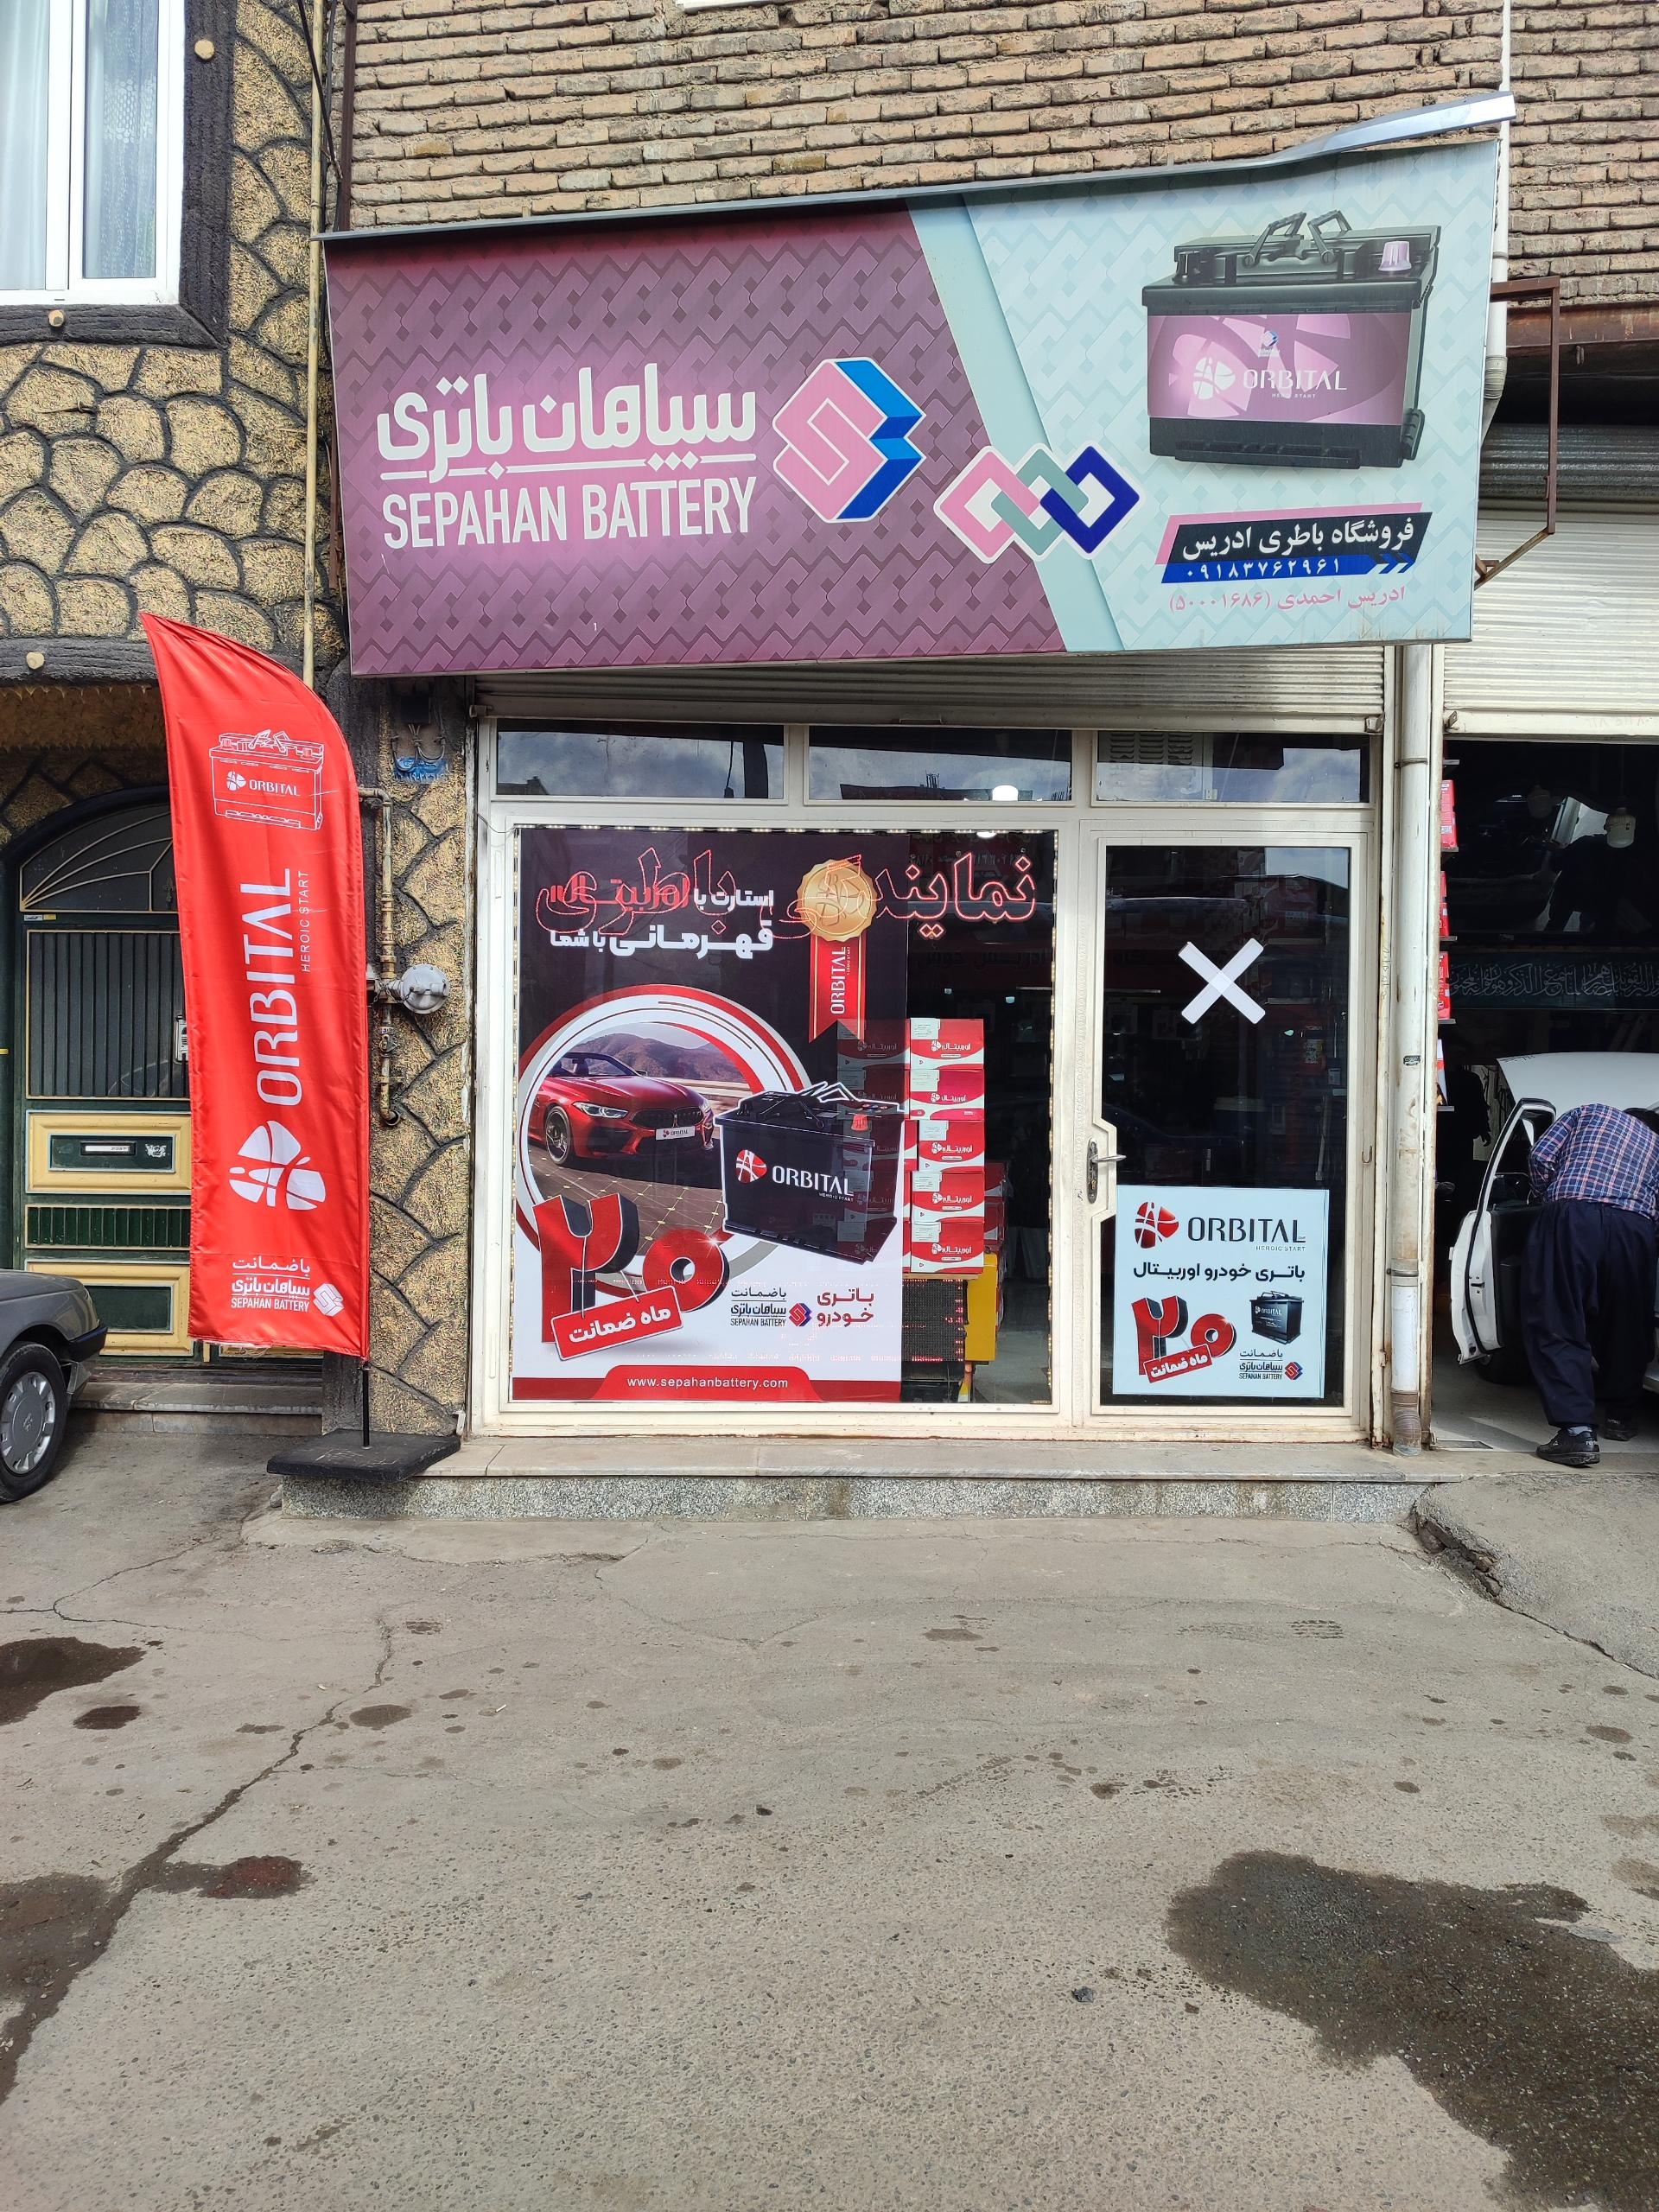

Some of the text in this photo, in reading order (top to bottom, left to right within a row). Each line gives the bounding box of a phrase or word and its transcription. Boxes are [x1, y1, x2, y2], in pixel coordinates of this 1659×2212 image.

[1243, 369, 1348, 391] ORBITAL
[376, 362, 758, 484] سپاهان باتری
[383, 476, 758, 550] SEPAHAN BATTERY
[1181, 517, 1414, 561] فروشگاه باطری ادریس
[1277, 588, 1342, 610] احمدی
[1347, 585, 1406, 610] ادریس
[249, 779, 301, 797] ORBITAL
[297, 870, 312, 973] HEROIC START
[550, 928, 591, 948] شما
[608, 919, 775, 960] قهرمانی
[238, 867, 302, 1107] ORBITAL
[830, 946, 847, 1016] ORBITAL
[772, 1165, 855, 1197] ORBITAL
[1187, 1217, 1306, 1243] ORBITAL
[1133, 1262, 1306, 1282] باتری خودرو اوربیتال
[231, 1297, 310, 1313] SEPAHAN BATTERY
[817, 1287, 875, 1307] باتری
[569, 1306, 671, 1343] ماه ضمانت
[730, 1318, 786, 1327] SEPAHAN BATTERY
[817, 1308, 874, 1327] خودرو
[1150, 1351, 1208, 1378] ماه ضمانت
[626, 1376, 788, 1390] www.sepahanbattery.com
